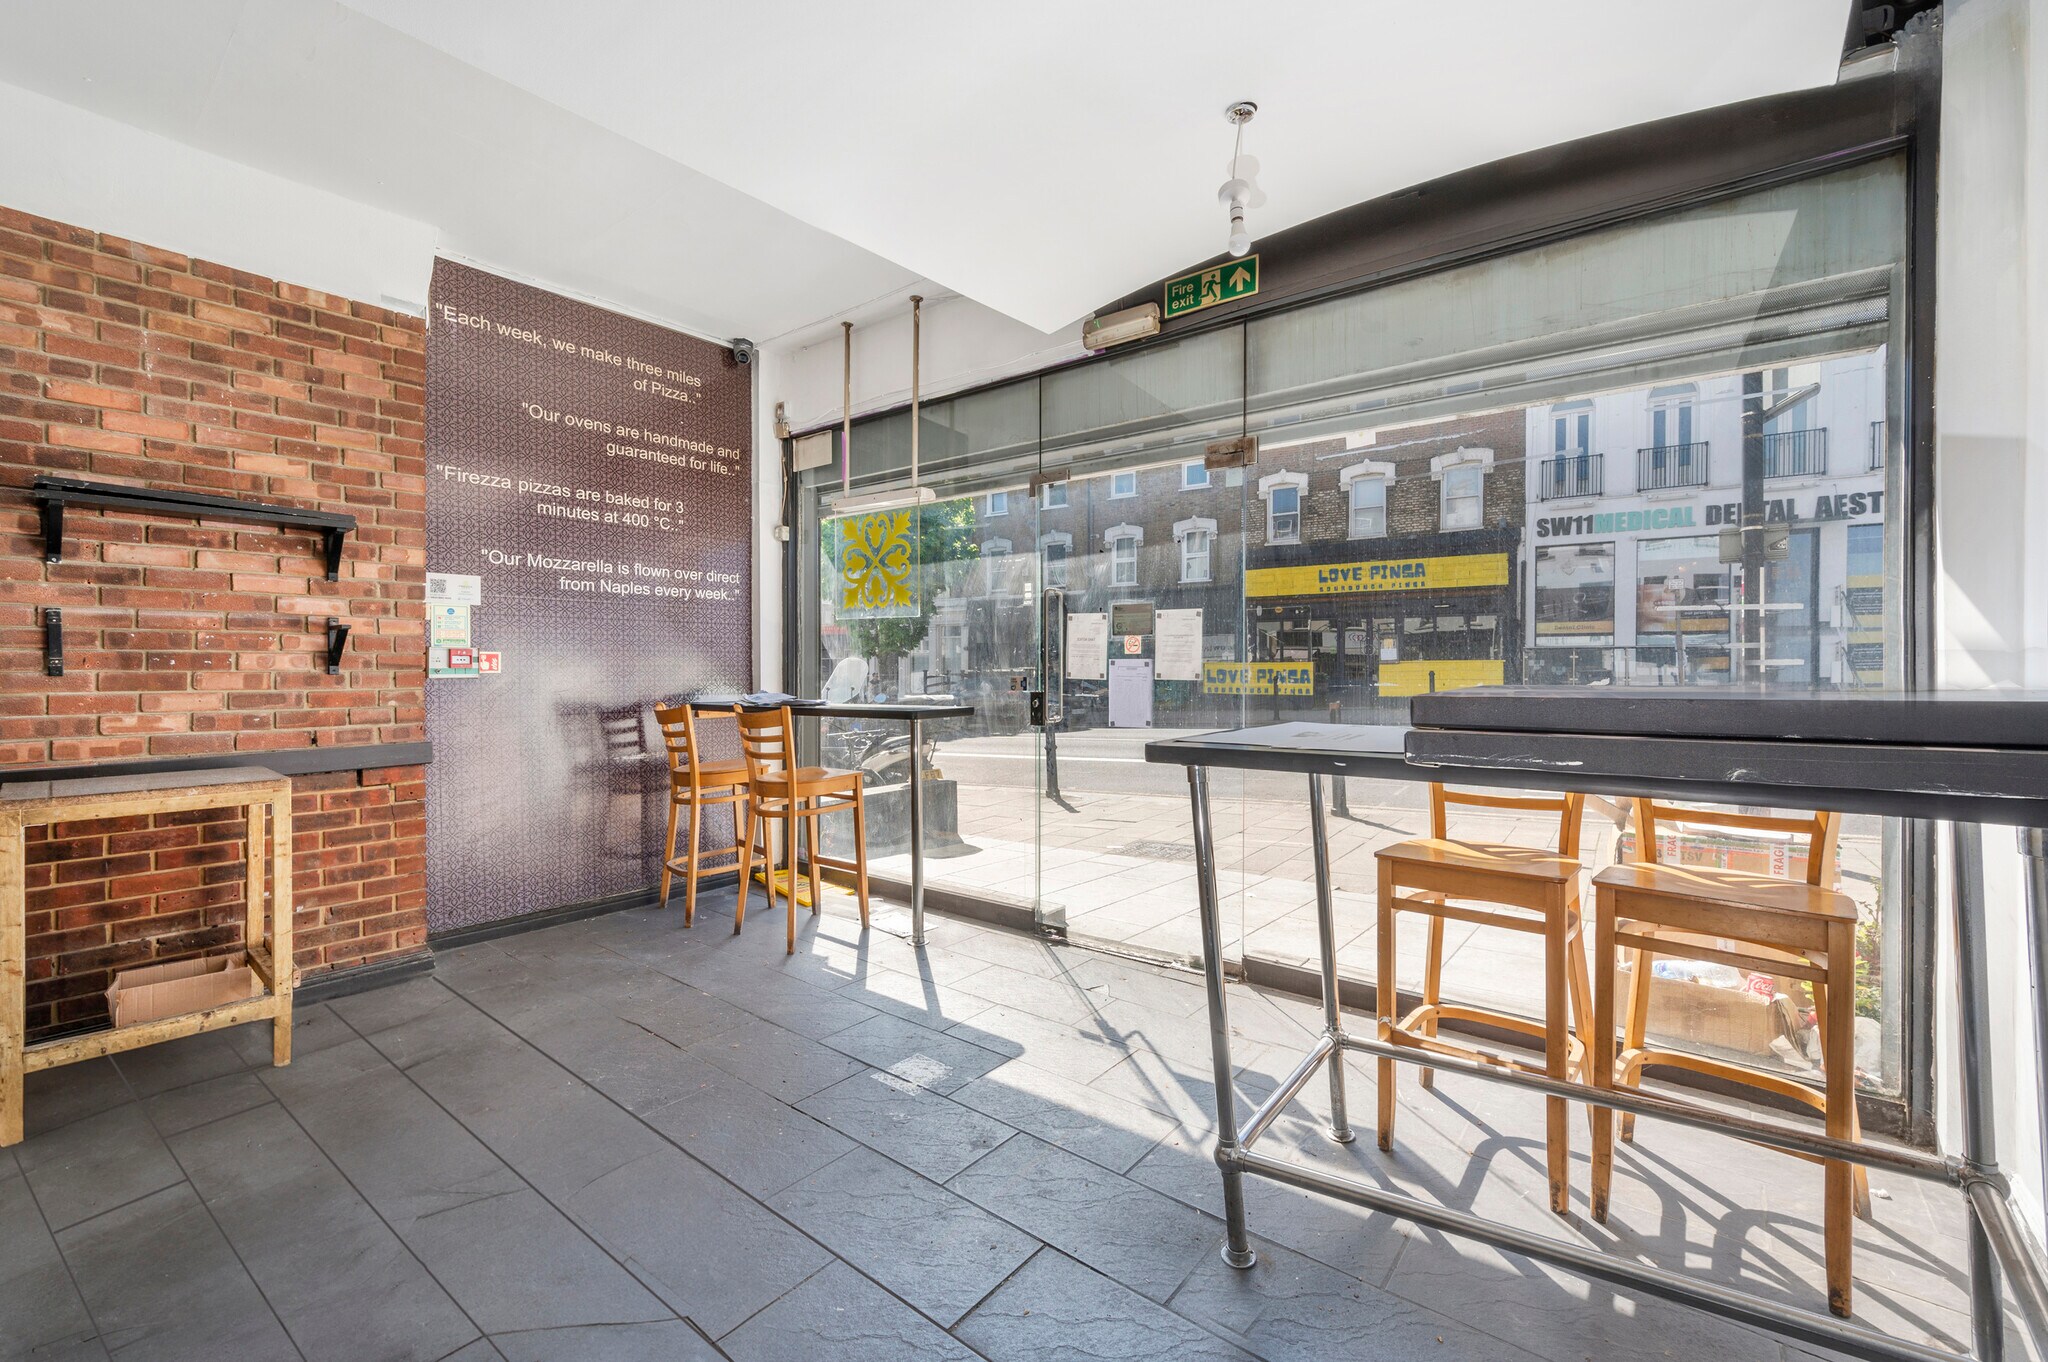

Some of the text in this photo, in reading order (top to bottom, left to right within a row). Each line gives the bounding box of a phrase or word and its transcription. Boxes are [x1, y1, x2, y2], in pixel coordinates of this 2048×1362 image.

[1172, 284, 1194, 297] Fire
[1172, 294, 1194, 309] exit
[435, 303, 702, 387] "Each week, we make three miles
[633, 375, 649, 392] of
[522, 402, 740, 460] "Our ovens are handmade and
[606, 442, 686, 468] guaranteed
[689, 454, 707, 470] for
[436, 464, 684, 514] "Firezza pizzas are baked for 3
[537, 500, 600, 522] minutes
[604, 507, 619, 524] at
[622, 510, 649, 528] 400
[480, 549, 740, 584] "Our Mozzarella is flown over direct
[1319, 563, 1426, 583] LOVE PINSA
[559, 576, 595, 593] from
[600, 577, 651, 597] Naples
[654, 583, 690, 601] every
[1206, 669, 1311, 684] LOVE PINSA
[1750, 978, 1774, 993] Coca
